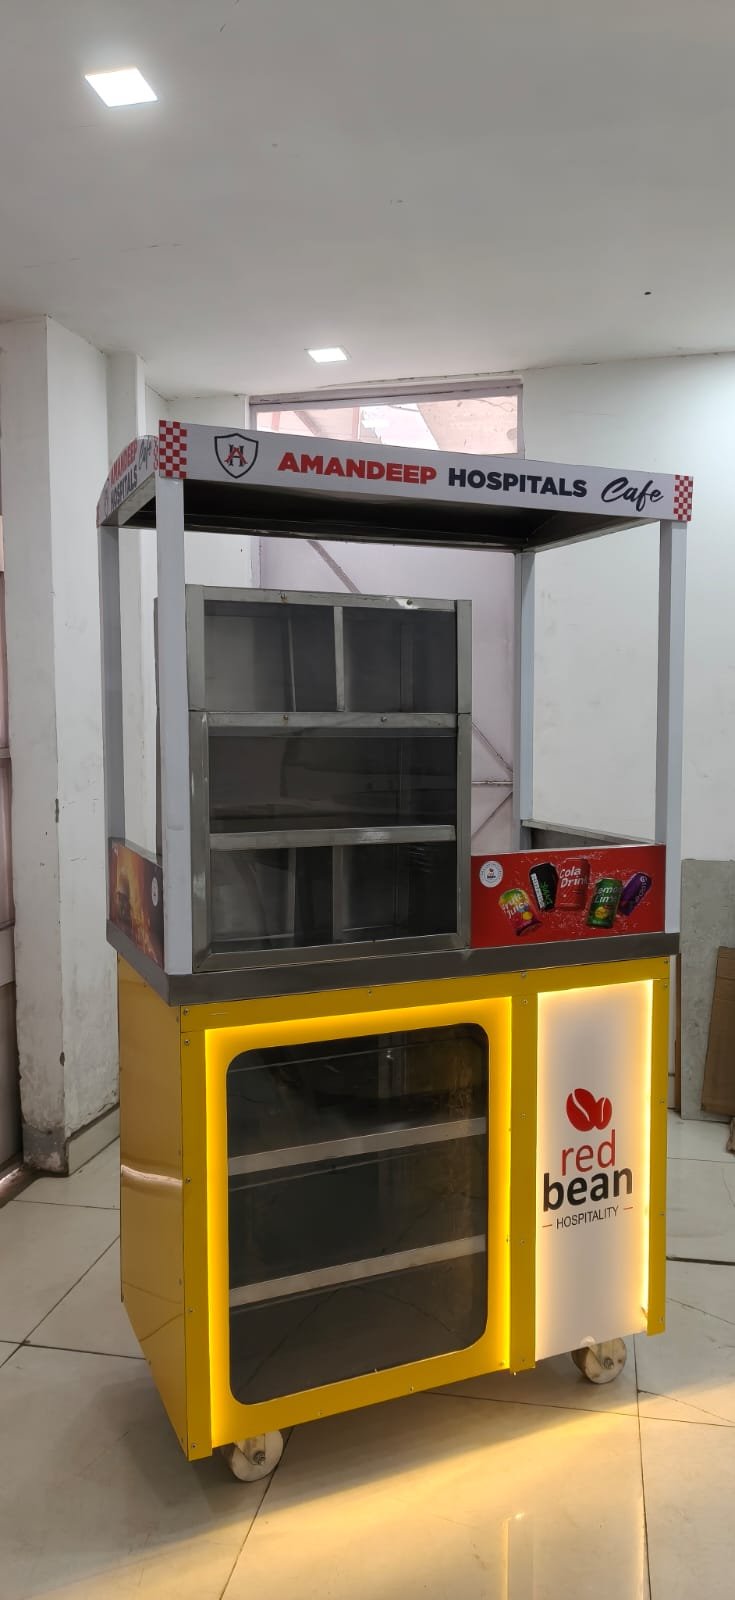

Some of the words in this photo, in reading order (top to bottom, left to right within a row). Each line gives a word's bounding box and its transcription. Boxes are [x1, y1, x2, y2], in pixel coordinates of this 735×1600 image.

[278, 452, 437, 485] AMANDEEP
[448, 467, 588, 498] HOSPITALS
[600, 476, 664, 512] Cafe
[560, 866, 582, 879] Cola
[560, 1129, 616, 1177] red
[543, 1167, 633, 1213] bean
[556, 1205, 619, 1230] HOSPITALITY
